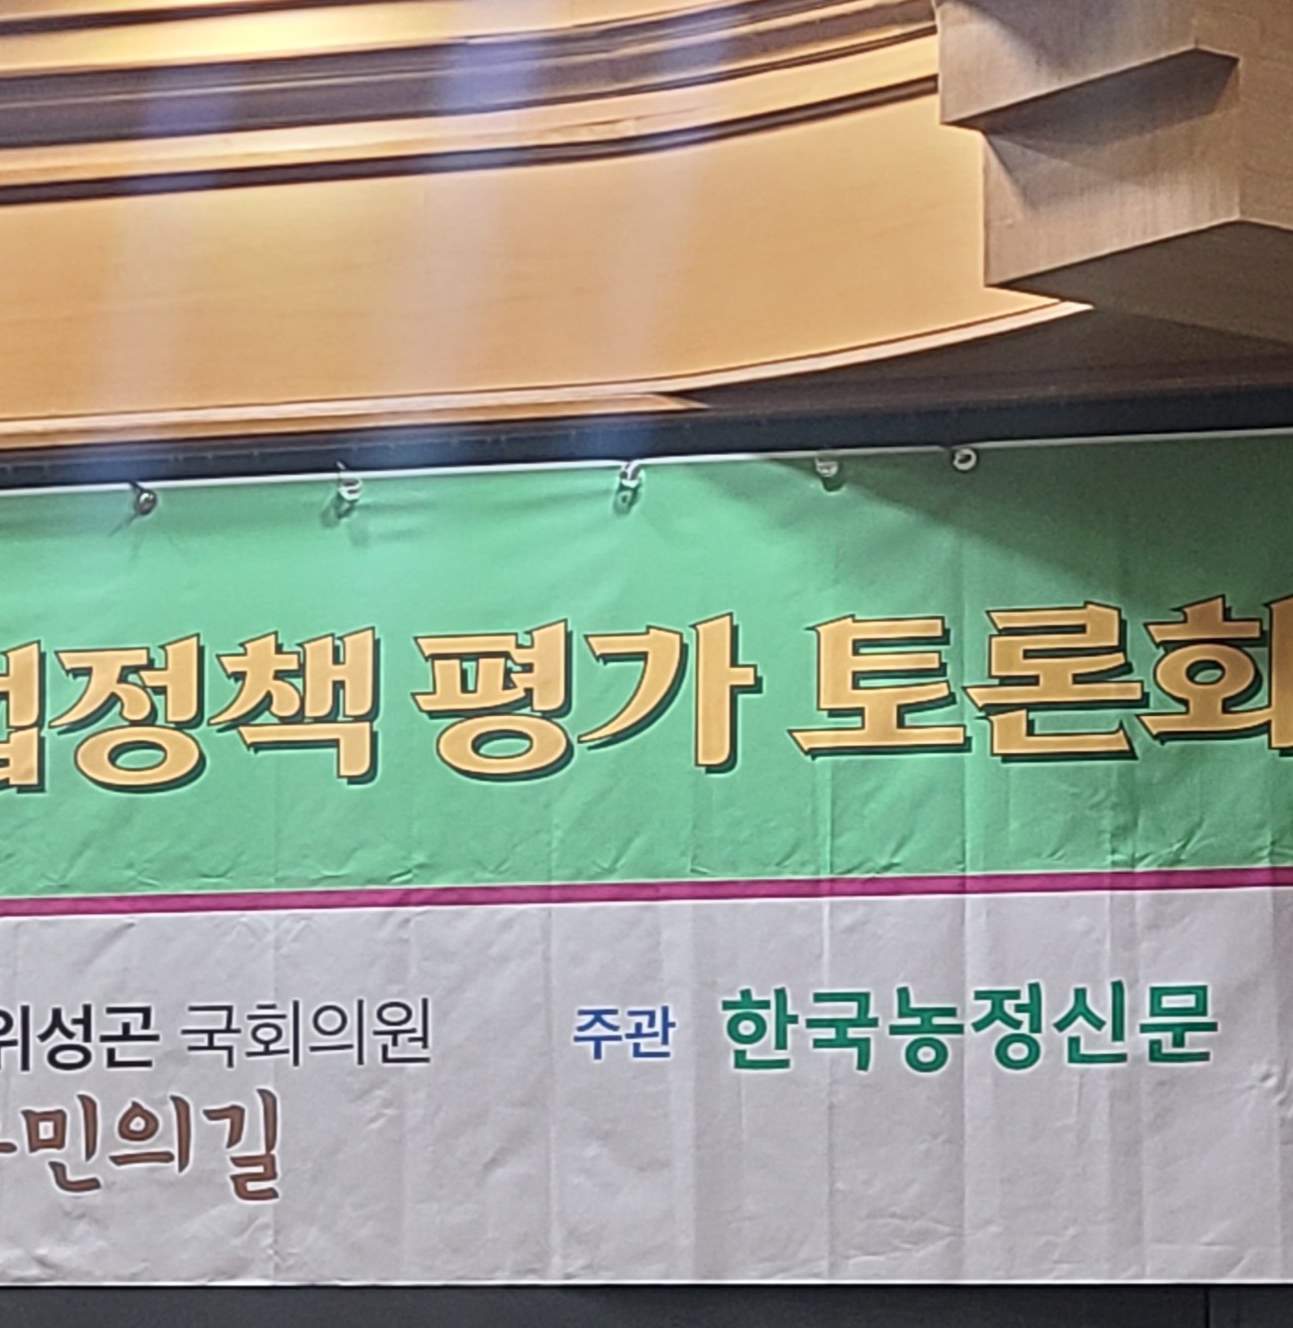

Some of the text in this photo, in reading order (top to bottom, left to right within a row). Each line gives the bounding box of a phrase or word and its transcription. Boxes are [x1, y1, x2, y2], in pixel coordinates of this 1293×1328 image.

[412, 611, 764, 780] 평가
[786, 592, 1293, 762] 토론회
[181, 998, 430, 1068] 국회의원
[574, 980, 1218, 1072] 주관 한국농정신문
